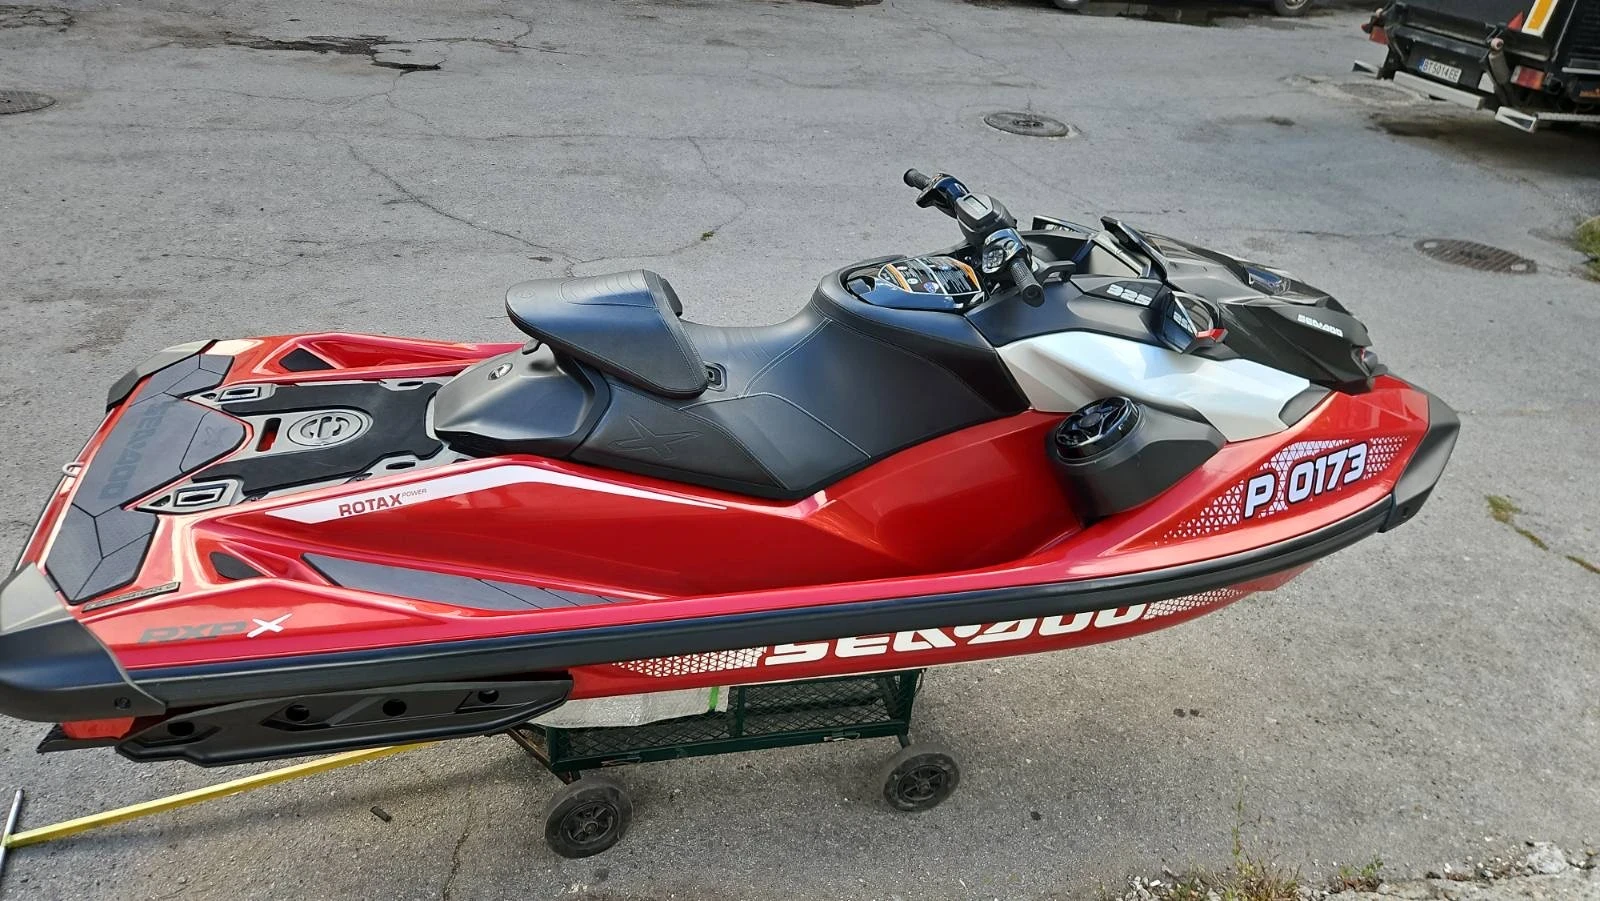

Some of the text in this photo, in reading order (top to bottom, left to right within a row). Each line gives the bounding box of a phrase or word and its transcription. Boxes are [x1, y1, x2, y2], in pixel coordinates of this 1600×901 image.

[338, 488, 427, 516] ROTAX POWER
[1244, 442, 1368, 518] P 0173
